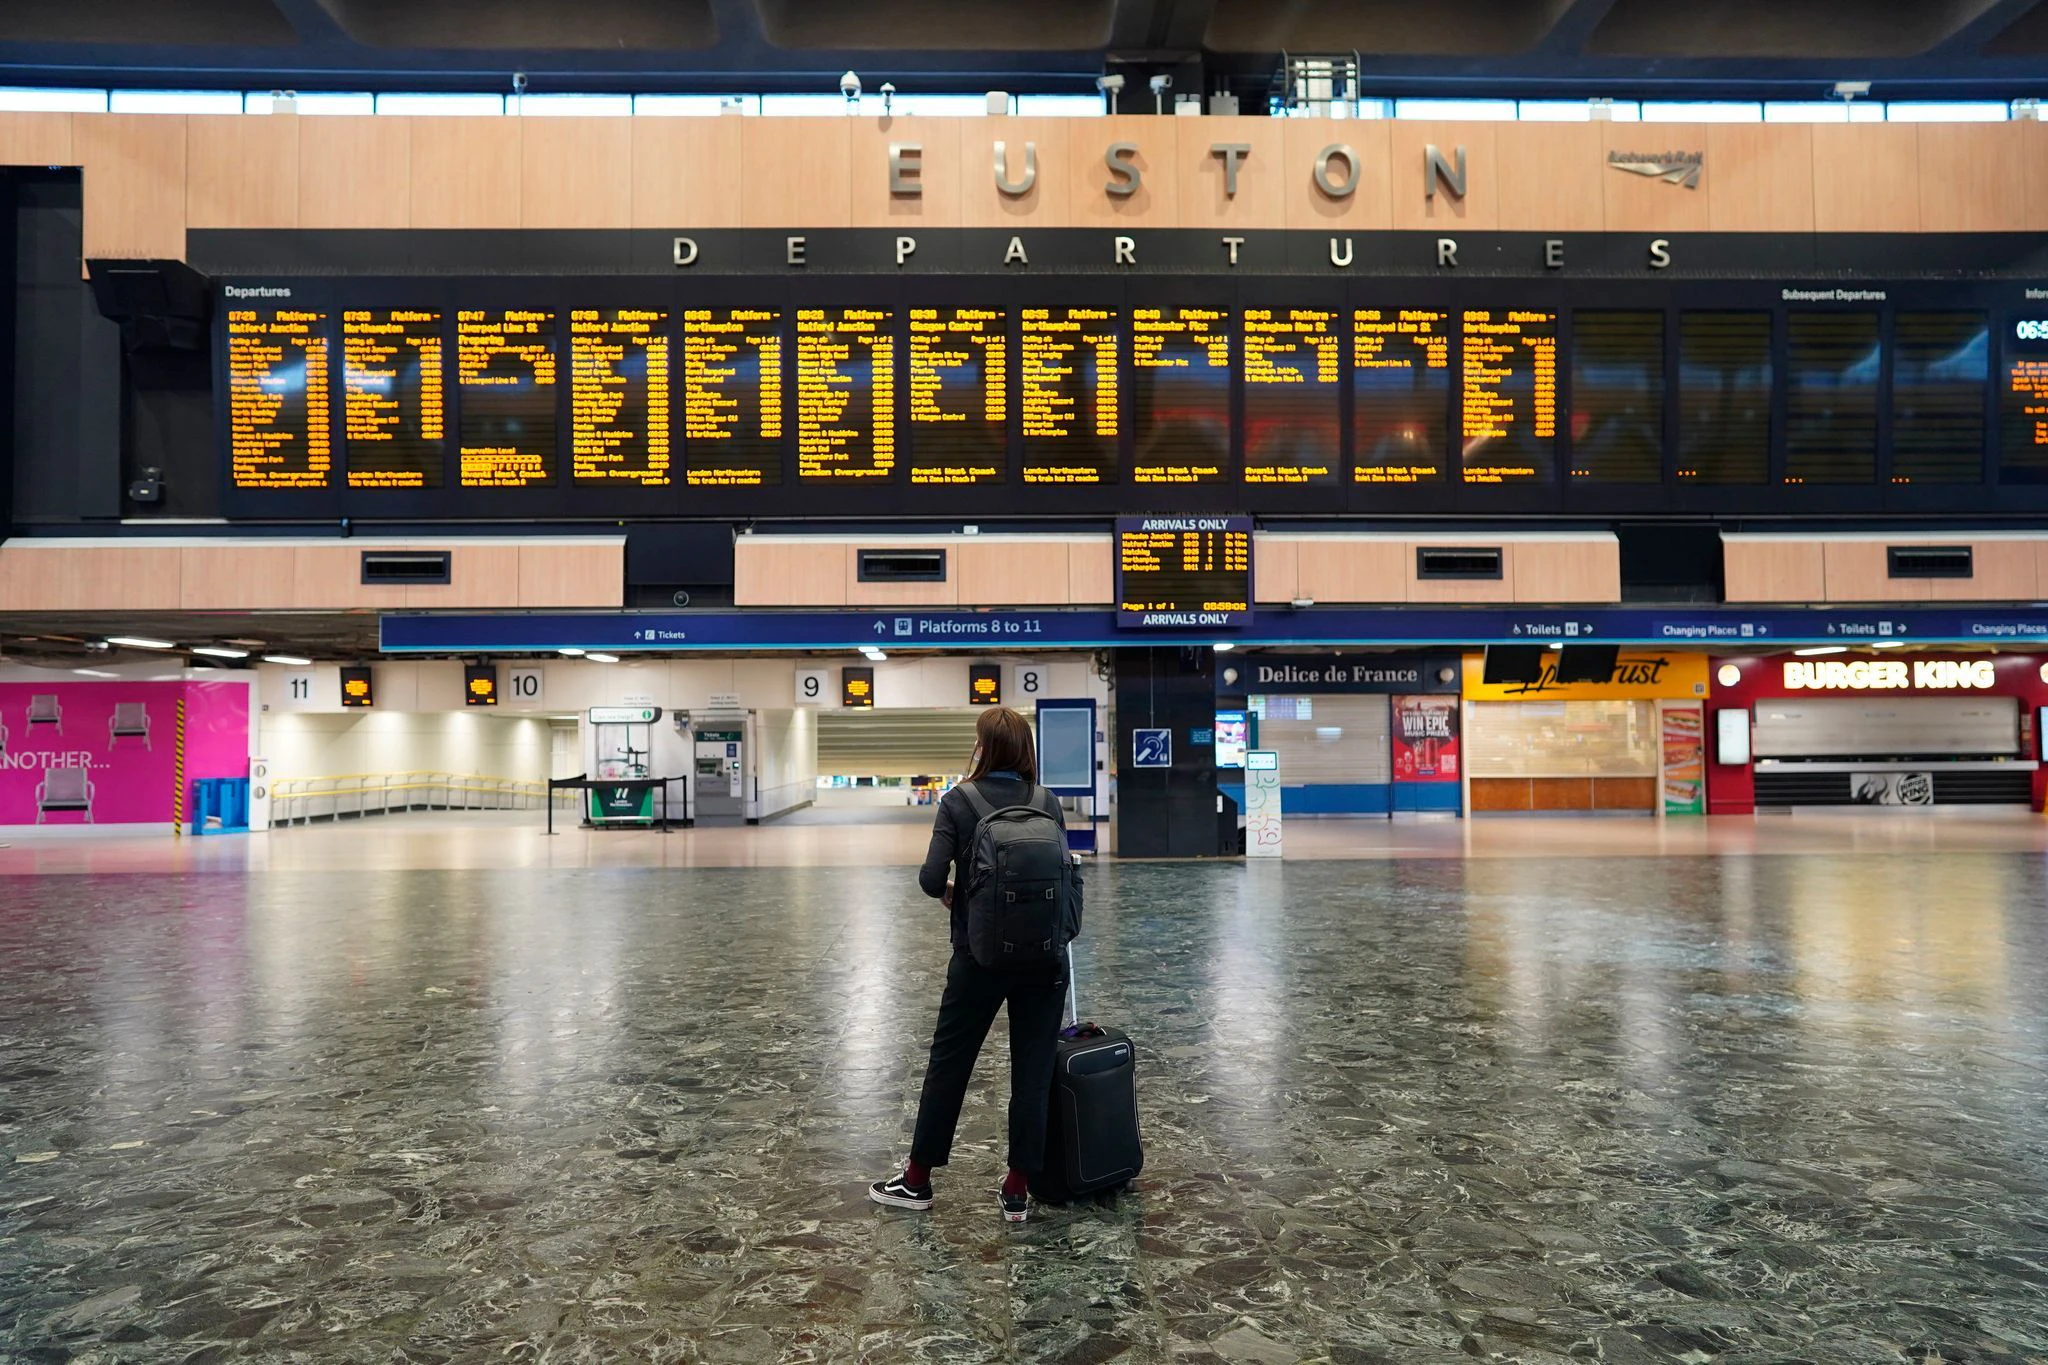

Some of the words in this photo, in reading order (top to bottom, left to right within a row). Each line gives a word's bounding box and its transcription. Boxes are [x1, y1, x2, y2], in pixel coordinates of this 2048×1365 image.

[888, 140, 1467, 198] EUSTON
[672, 236, 1671, 268] DEPARTURES
[225, 286, 291, 299] Departures
[1782, 289, 1835, 302] Subsequent
[1836, 289, 1886, 302] Departures
[276, 311, 318, 321] Platform
[391, 312, 432, 322] Platform
[458, 311, 485, 322] 07:47
[505, 311, 546, 322] Platform
[618, 310, 658, 321] Platform
[731, 310, 772, 321] Platform
[844, 310, 884, 320] Platform
[956, 310, 996, 320] Platform
[1068, 310, 1108, 320] Platform
[1180, 310, 1218, 320] Platform
[1290, 310, 1330, 321] Platform
[1399, 310, 1438, 321] Platform
[1508, 311, 1546, 322] Platform
[229, 323, 267, 333] Watford
[270, 323, 308, 333] Junction
[344, 324, 404, 334] Northampton
[458, 323, 502, 334] Liverpool
[504, 323, 525, 334] Lime
[572, 322, 609, 333] Watford
[611, 322, 650, 333] Junction
[684, 322, 744, 333] Northampton
[797, 322, 834, 332] Watford
[836, 322, 875, 332] Junction
[910, 321, 946, 332] Glasgow
[948, 321, 983, 332] Central
[1022, 321, 1080, 332] Northampton
[1134, 321, 1187, 332] Manchester
[1189, 321, 1208, 332] Picc
[1244, 322, 1293, 333] Birmingham
[1295, 322, 1314, 333] New
[1354, 322, 1396, 334] Liverpool
[1398, 322, 1419, 334] Lime
[1464, 323, 1520, 334] Northampton
[458, 335, 505, 346] Preparing
[234, 471, 267, 479] London
[269, 471, 324, 480] Overground
[574, 470, 607, 478] London
[609, 470, 664, 479] Overground
[800, 468, 832, 477] London
[834, 468, 888, 478] Overground
[1135, 467, 1164, 475] Avanti
[1167, 467, 1190, 475] West
[1192, 467, 1218, 475] Coast
[1245, 467, 1274, 475] Avanti
[1277, 467, 1299, 475] West
[1301, 467, 1328, 475] Coast
[1355, 467, 1384, 475] Avanti
[1386, 467, 1408, 475] West
[1410, 467, 1436, 475] Coast
[1142, 519, 1196, 530] ARRIVALS
[1198, 519, 1228, 530] ONLY
[1122, 540, 1148, 548] Watford
[1148, 540, 1174, 548] Junction
[1234, 540, 1248, 548] time
[1234, 548, 1248, 556] time
[1122, 556, 1160, 564] Northampton
[1234, 556, 1248, 564] time
[1122, 564, 1160, 572] Northampton
[1234, 564, 1248, 572] time
[1122, 603, 1144, 611] Page
[1148, 602, 1152, 610] 1
[1156, 602, 1166, 610] of
[1170, 602, 1174, 610] 1
[1143, 614, 1196, 625] ARRIVALS
[1199, 614, 1229, 625] ONLY
[919, 619, 988, 634] Platforms
[991, 620, 1001, 633] 8
[1004, 620, 1020, 633] to
[1023, 620, 1042, 633] 11
[1526, 624, 1562, 635] Toilets
[1663, 625, 1707, 637] Changing
[1708, 625, 1737, 636] Places
[1840, 623, 1875, 634] Toilets
[1972, 623, 2016, 635] Changing
[2018, 623, 2047, 634] Places
[657, 630, 685, 640] Tickets
[1259, 665, 1320, 683] Delice
[1324, 665, 1347, 683] de
[1353, 665, 1418, 683] France
[1783, 660, 1909, 689] BURGER
[1913, 660, 1995, 689] KING
[512, 676, 538, 697] 10
[803, 677, 819, 697] 9
[1023, 672, 1038, 692] 8
[290, 678, 308, 699] 11
[1402, 716, 1424, 730] WIN
[1426, 716, 1449, 731] EPIC
[0, 751, 110, 769] NOTHER...
[1902, 786, 1929, 799] KING
